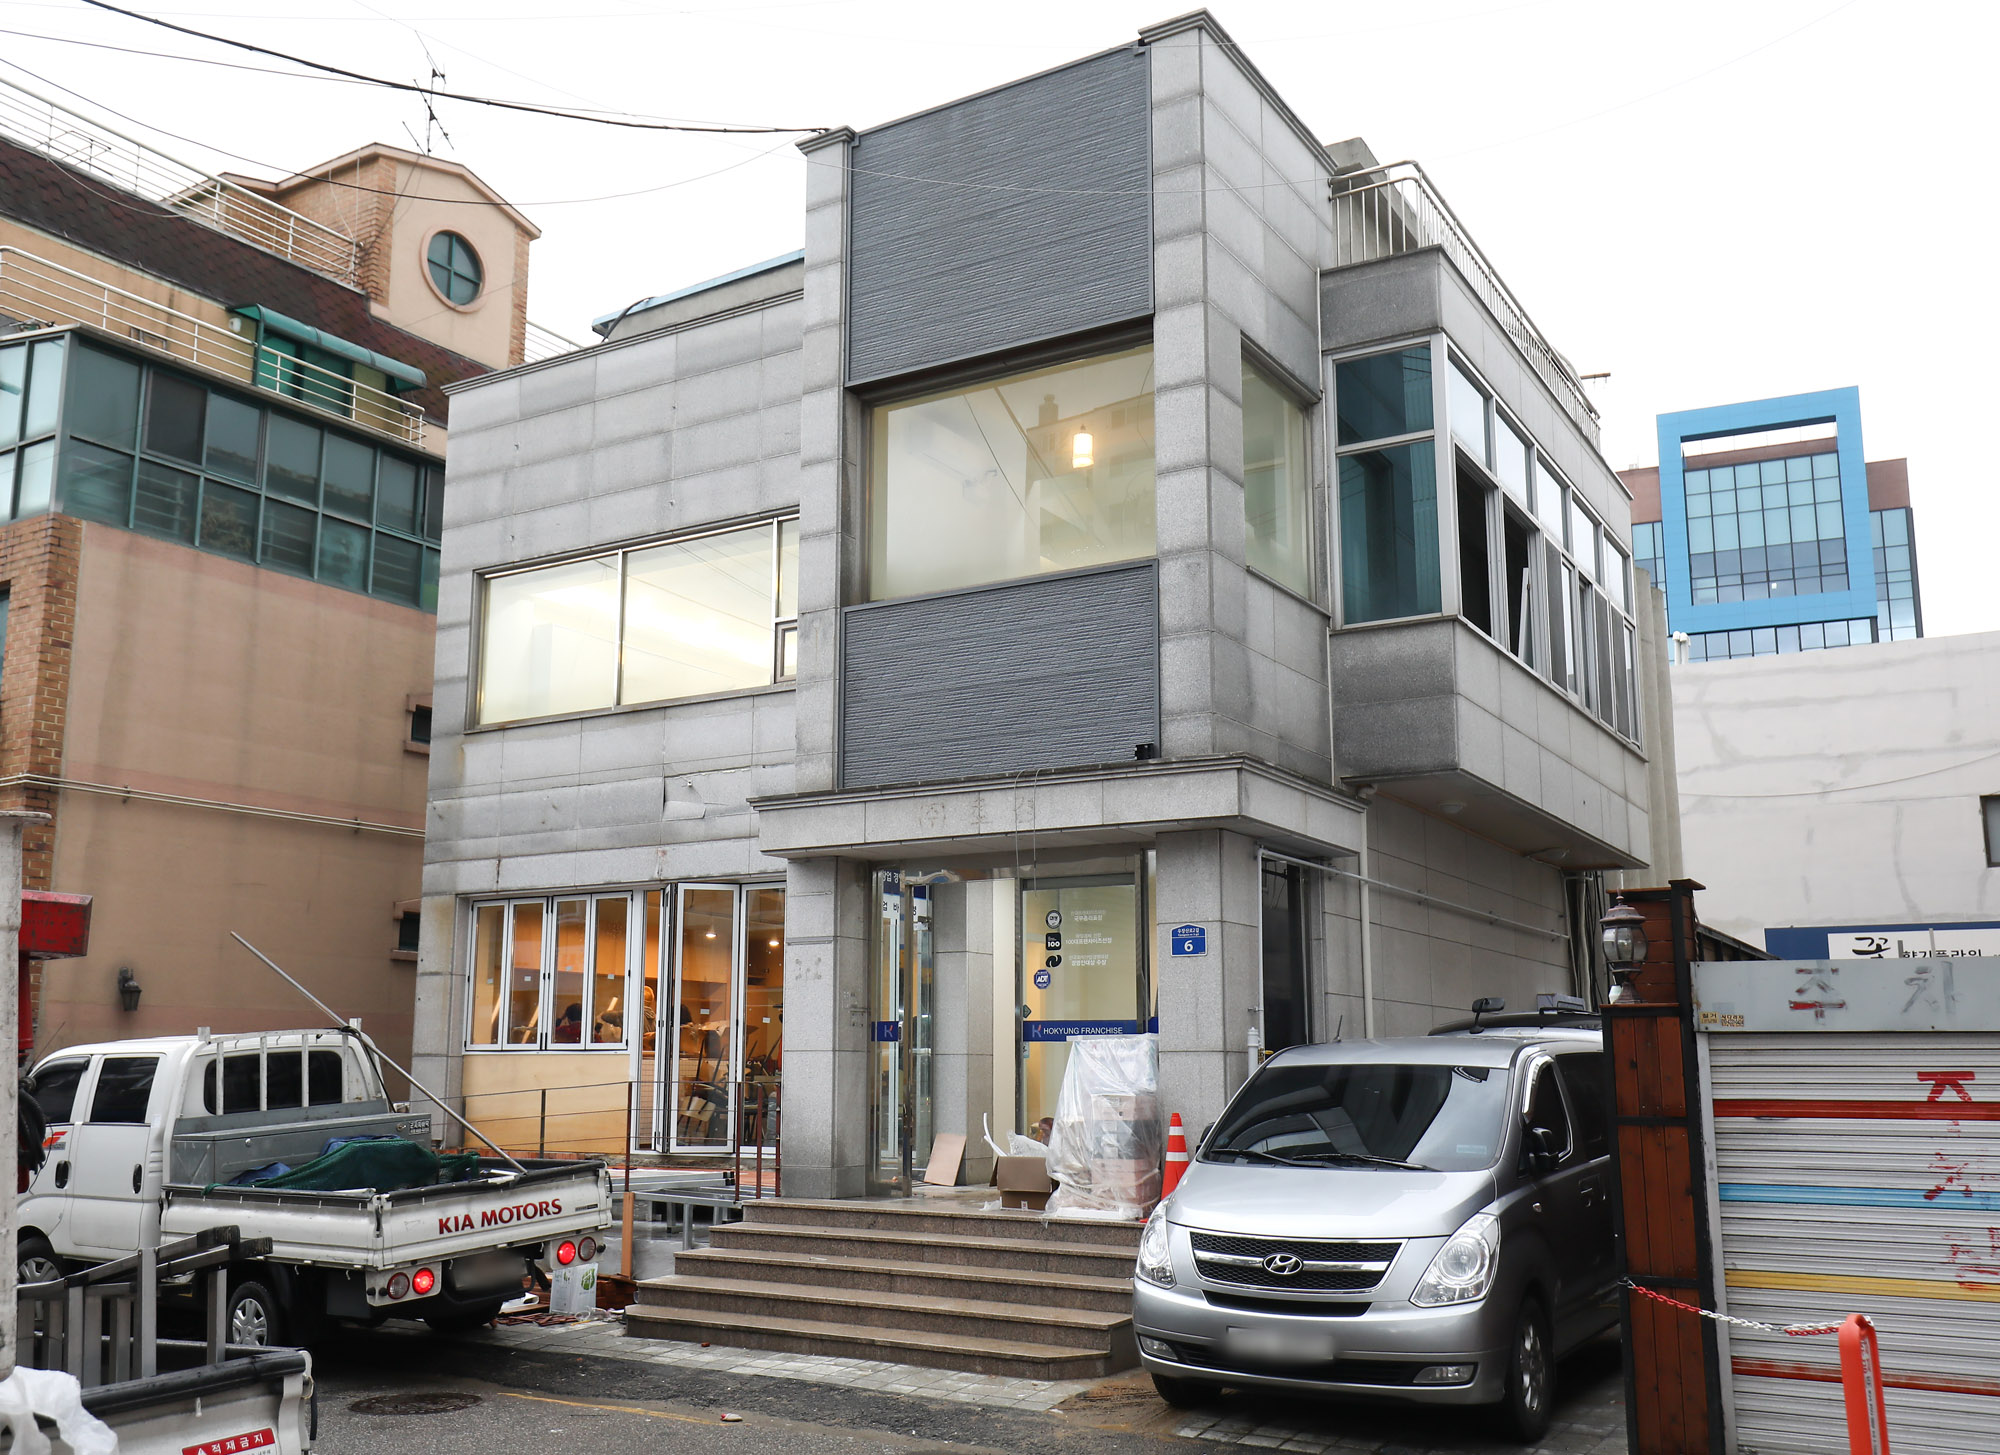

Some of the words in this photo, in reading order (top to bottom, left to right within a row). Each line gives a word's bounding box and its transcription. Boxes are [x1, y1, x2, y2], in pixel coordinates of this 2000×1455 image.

[1184, 939, 1194, 952] 6
[1043, 1027, 1080, 1035] HOKYUNG
[1081, 1026, 1124, 1035] FRANCHISE
[438, 1214, 475, 1235] KIA
[481, 1198, 563, 1228] MOTORS
[211, 1433, 264, 1454] 적재금지
